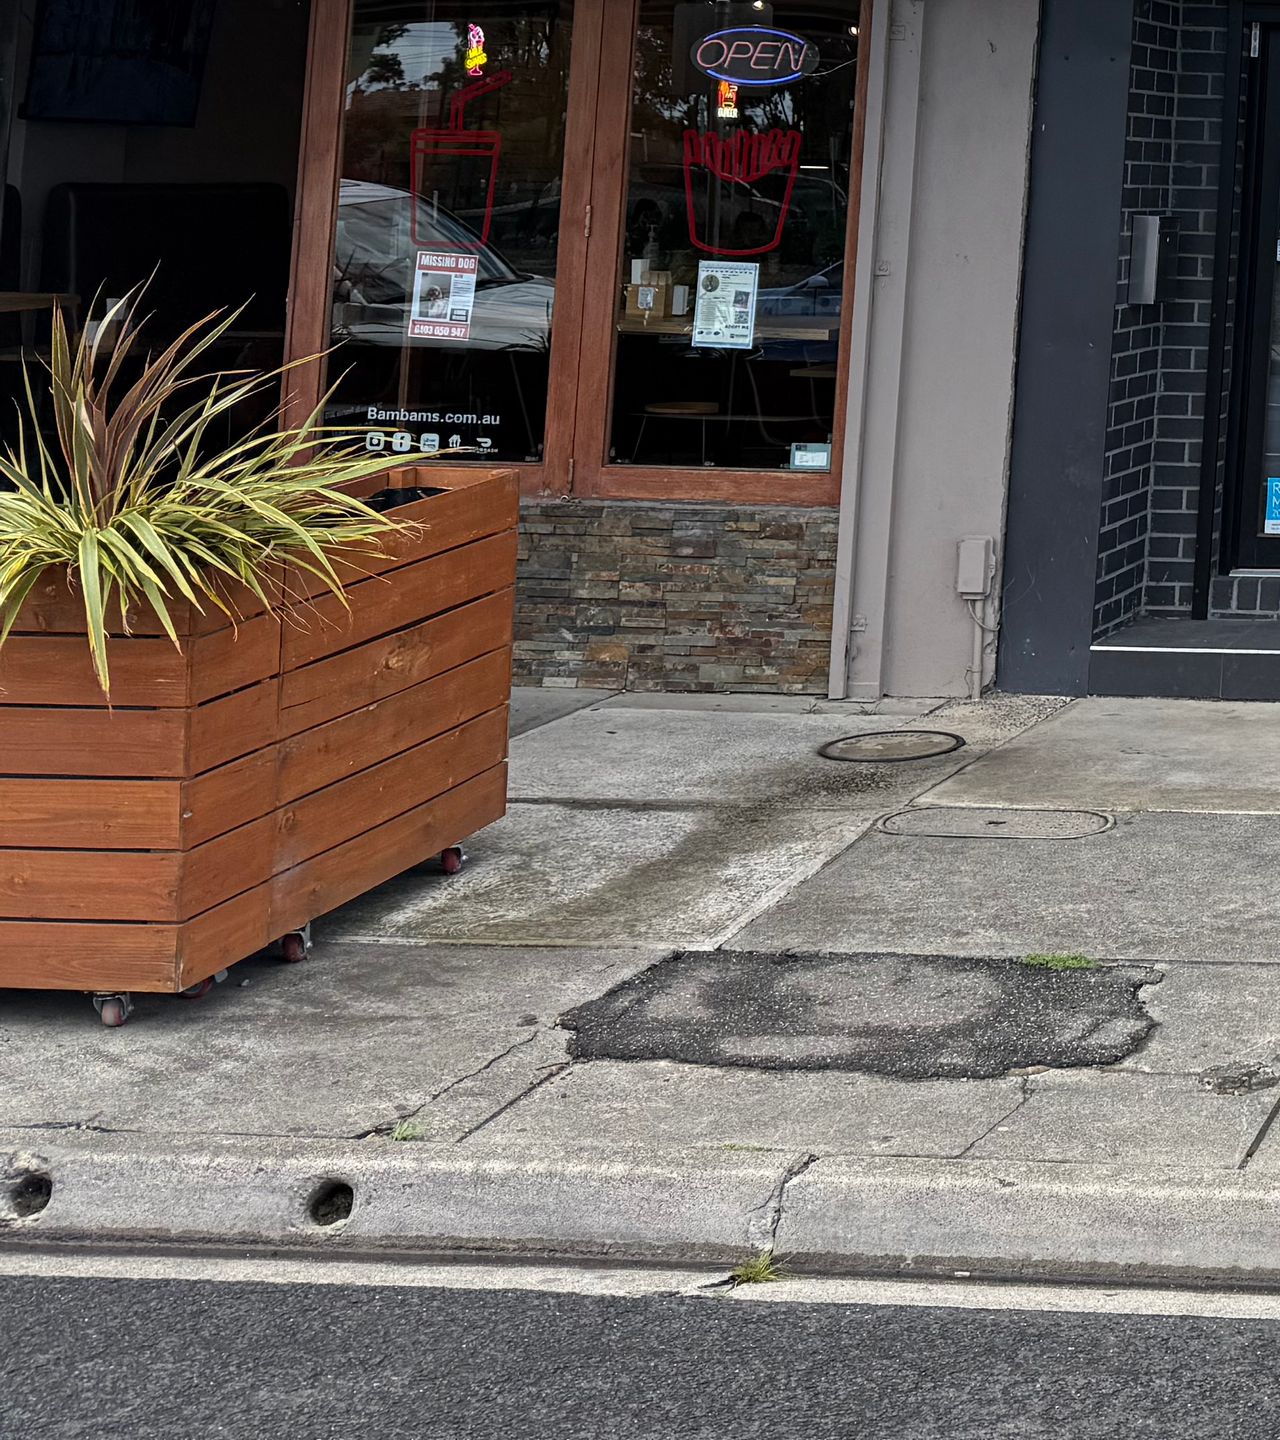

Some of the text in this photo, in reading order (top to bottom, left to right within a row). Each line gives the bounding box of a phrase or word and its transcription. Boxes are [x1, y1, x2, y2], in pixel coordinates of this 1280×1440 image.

[696, 39, 808, 71] OPEN
[420, 254, 475, 269] MISSING DOG
[367, 406, 501, 425] Bambams.com.au
